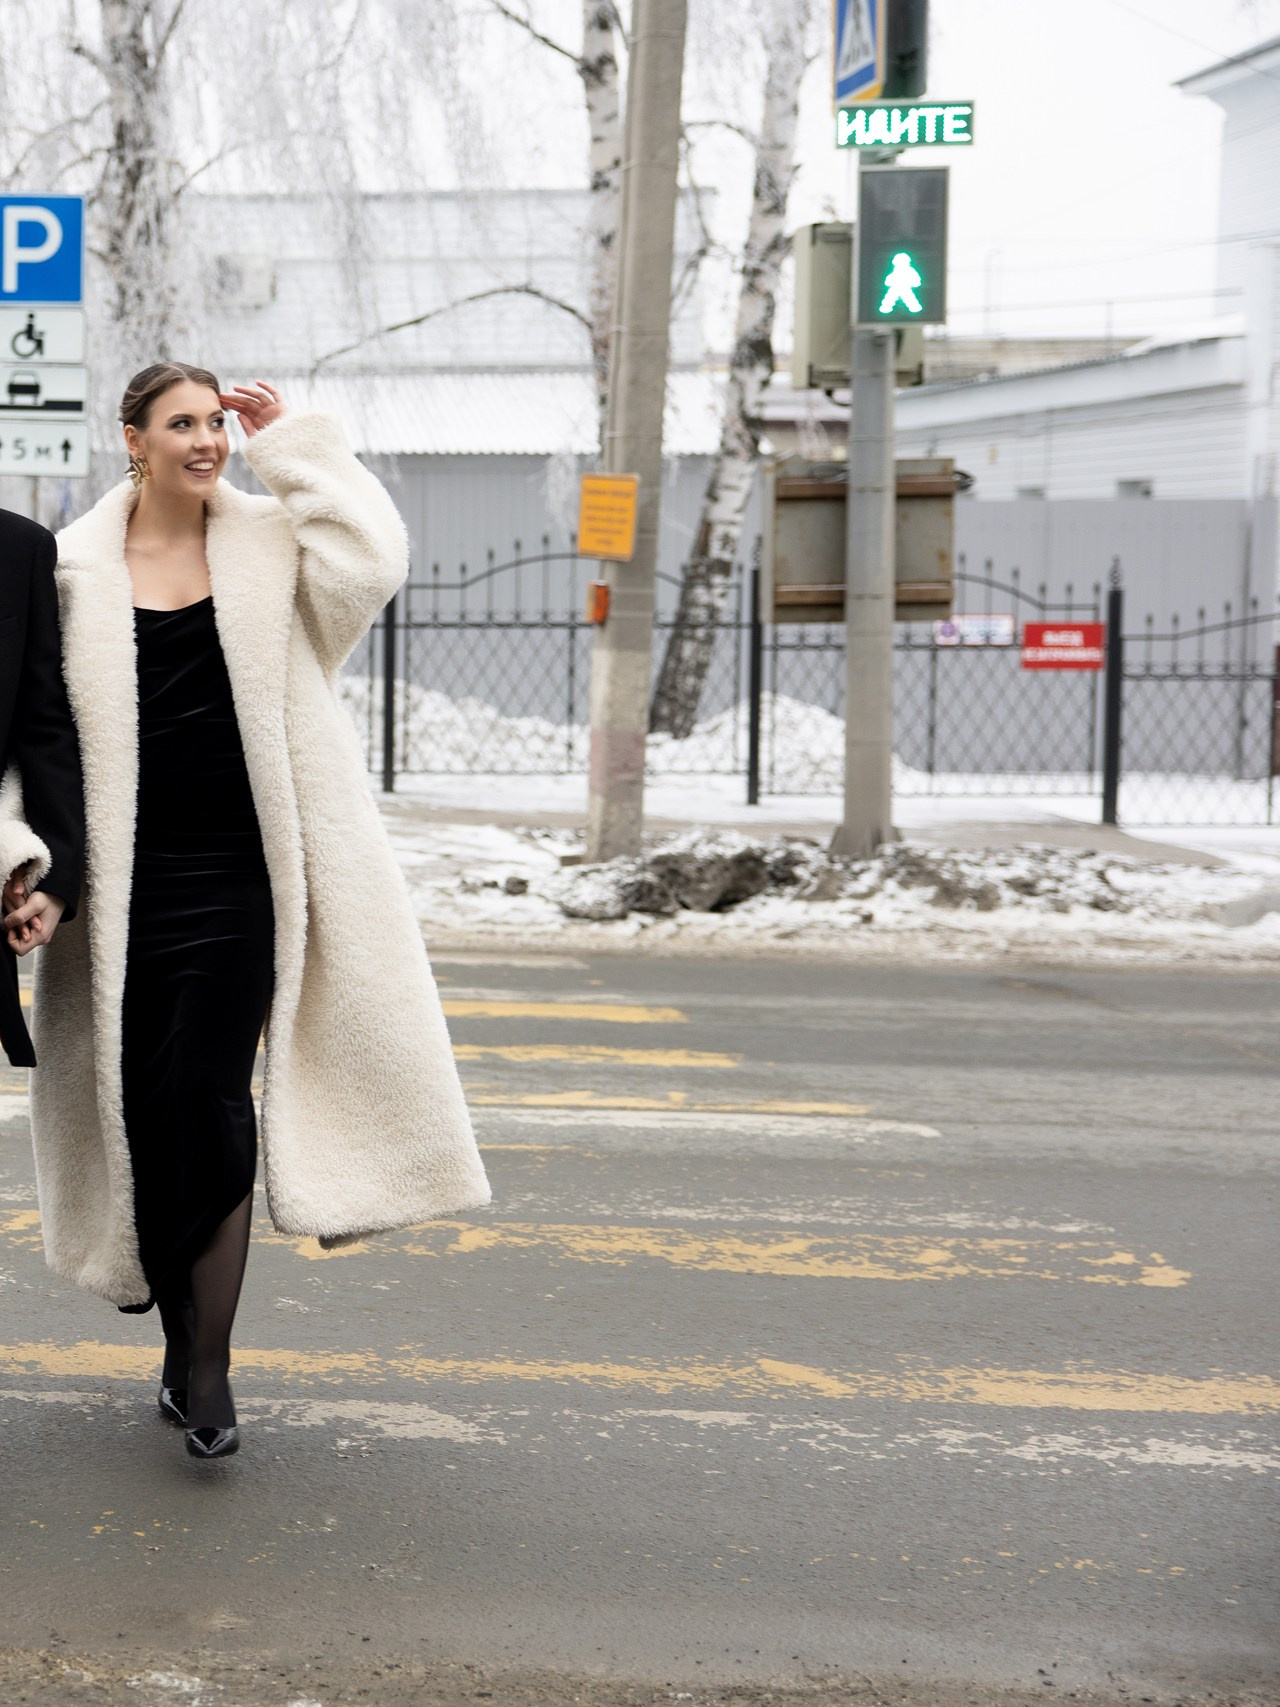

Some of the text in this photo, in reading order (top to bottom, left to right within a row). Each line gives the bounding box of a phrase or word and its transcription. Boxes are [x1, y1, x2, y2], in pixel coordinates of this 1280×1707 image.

[837, 106, 972, 145] ИДИТЕ
[2, 204, 64, 293] P
[12, 438, 27, 460] 5
